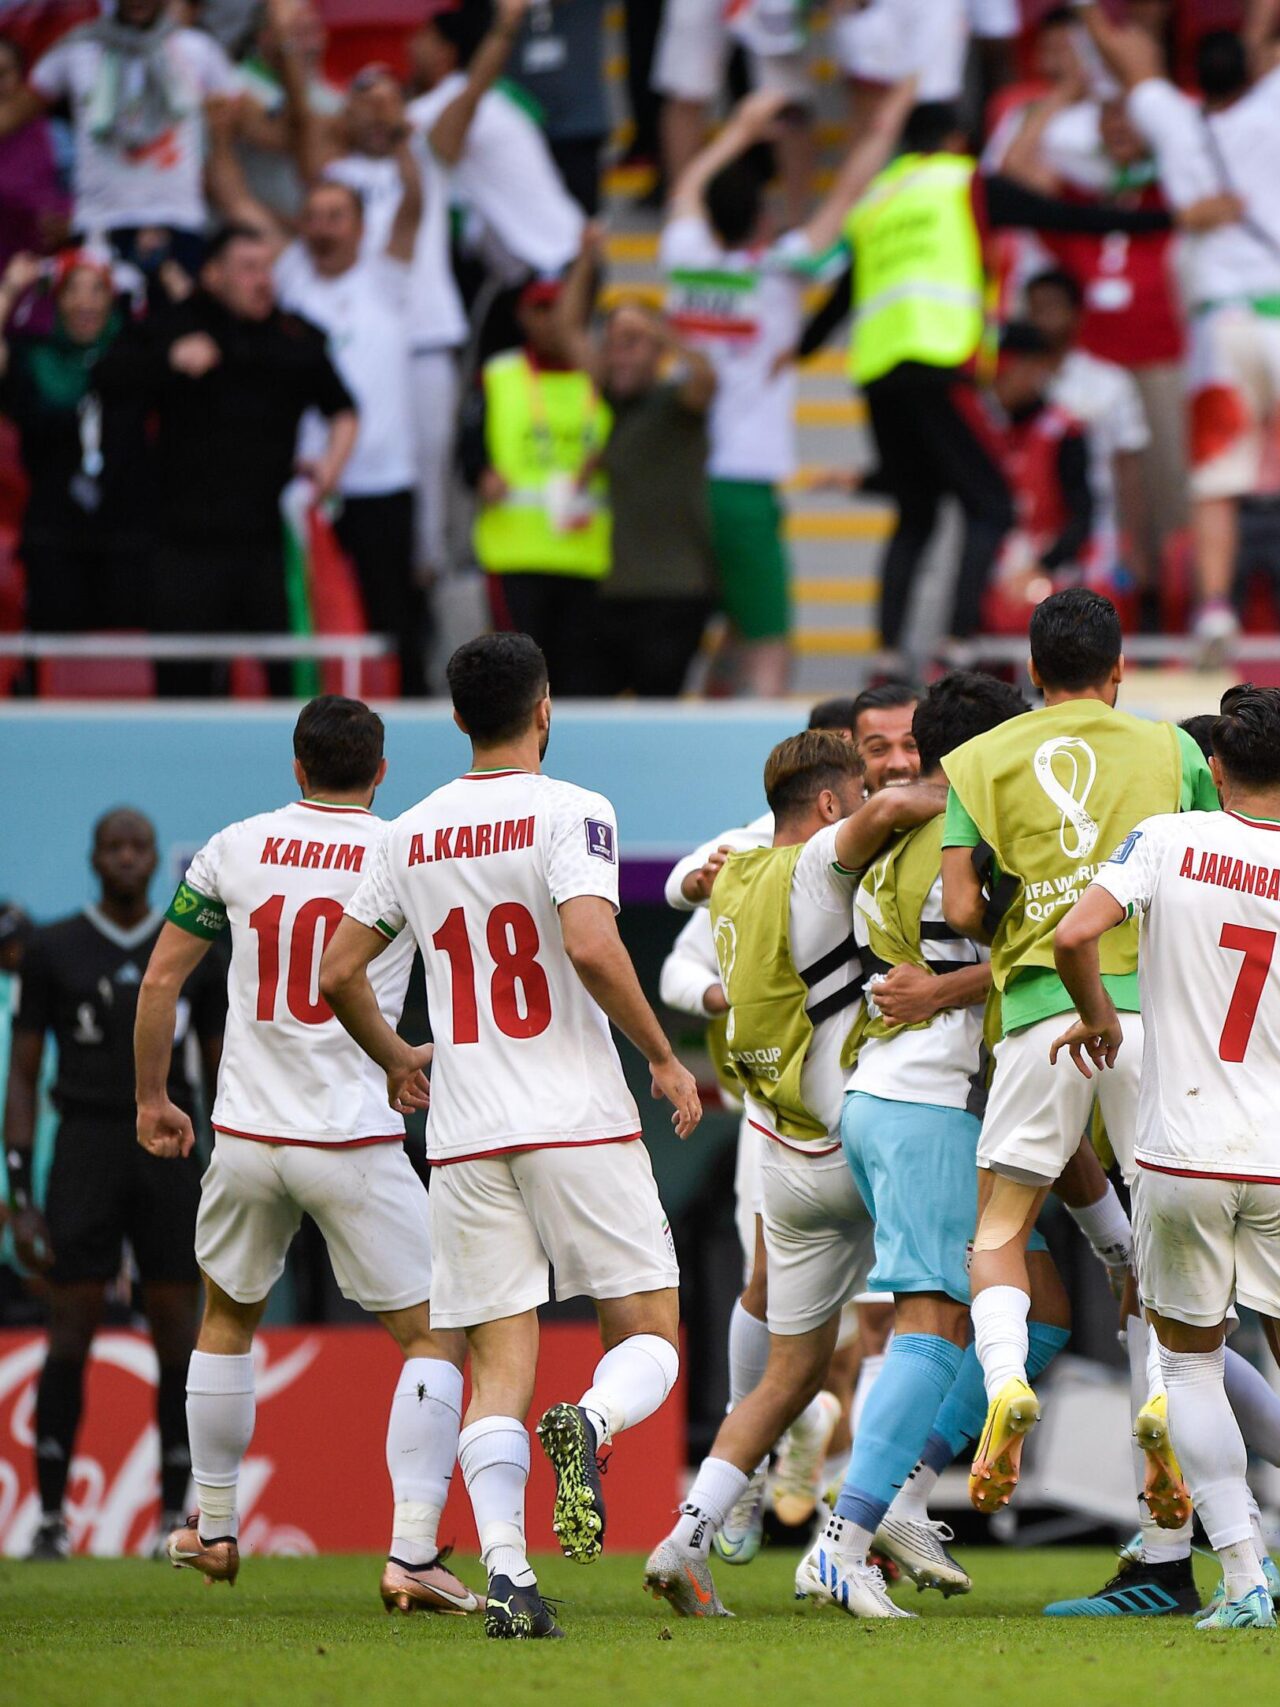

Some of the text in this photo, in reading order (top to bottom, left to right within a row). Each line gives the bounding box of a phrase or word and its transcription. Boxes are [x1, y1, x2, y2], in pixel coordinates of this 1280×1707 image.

[260, 837, 366, 873] KARIM
[408, 815, 536, 867] A.KARIMI
[249, 894, 345, 1026] 10
[432, 901, 552, 1045] 18
[1218, 922, 1277, 1063] 7
[755, 1047, 782, 1064] CUP
